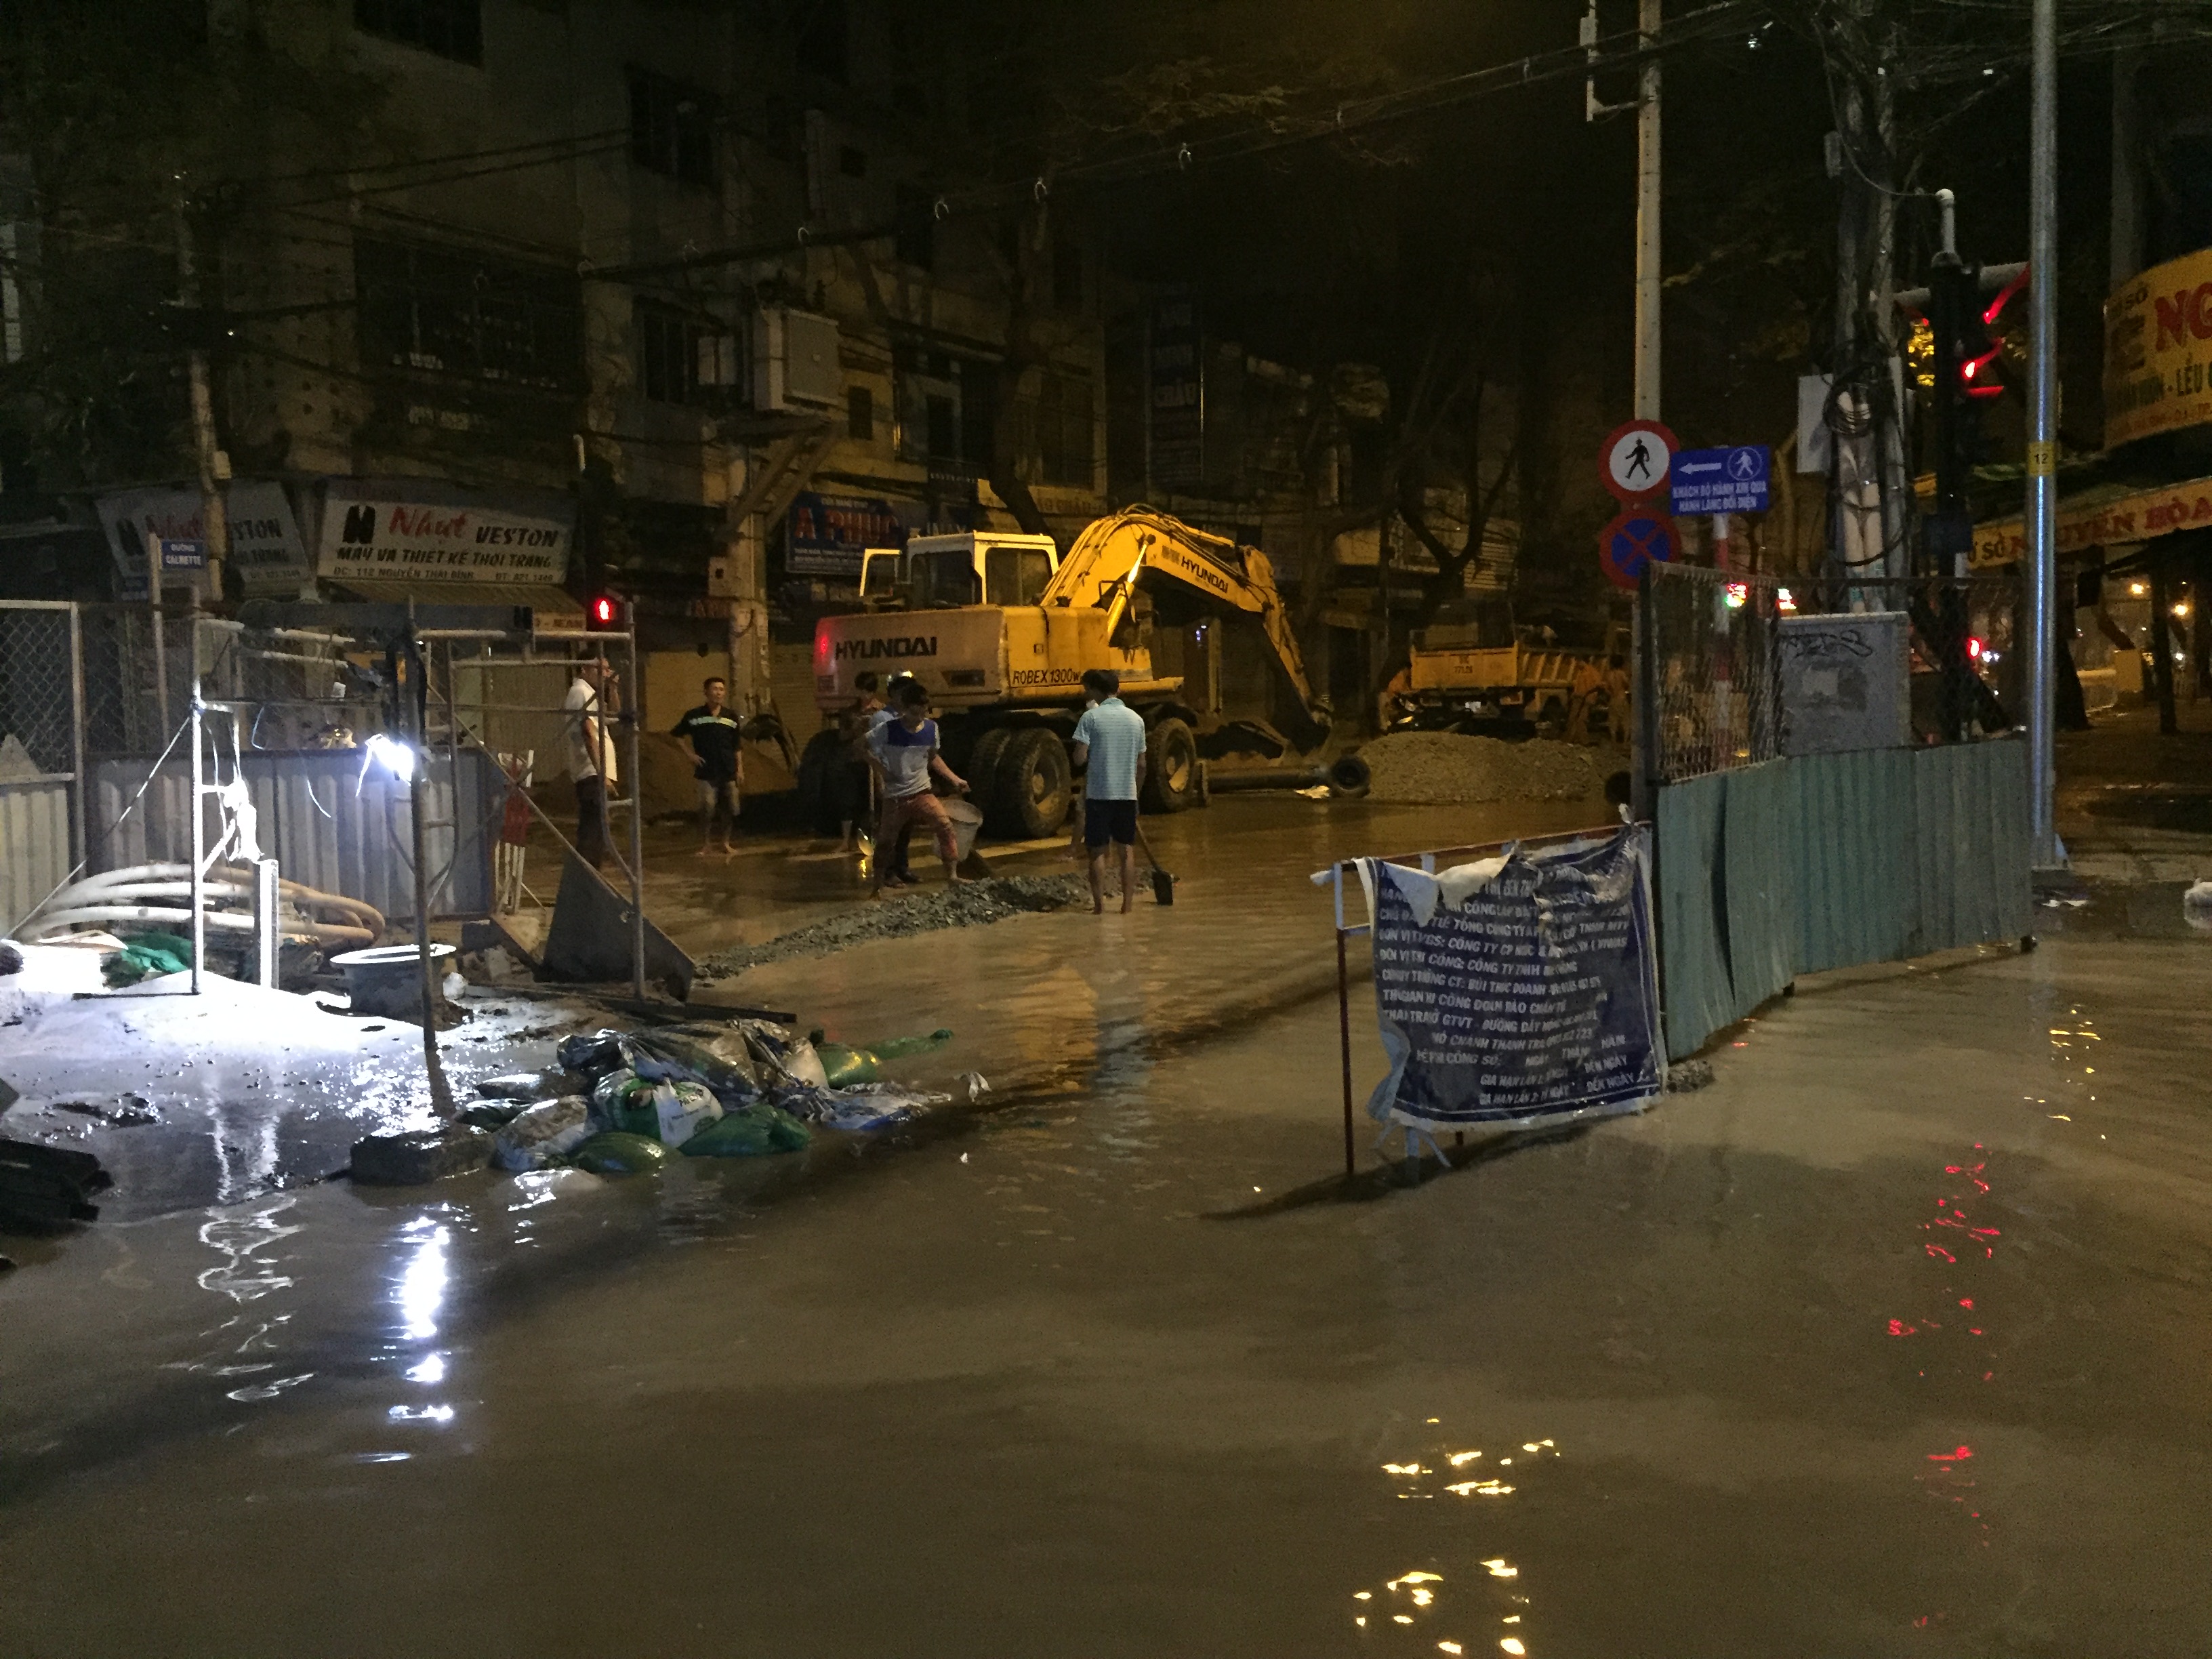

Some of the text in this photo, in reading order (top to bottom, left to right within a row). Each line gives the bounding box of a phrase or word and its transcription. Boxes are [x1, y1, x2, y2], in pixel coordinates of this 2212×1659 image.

[2034, 453, 2049, 464] 12
[476, 526, 558, 547] VESTON
[337, 547, 373, 560] MAY
[509, 554, 552, 568] TRANG
[1181, 556, 1229, 594] HYUNDAI
[835, 637, 937, 660] HYUNDAI
[1012, 670, 1048, 684] ROBEX
